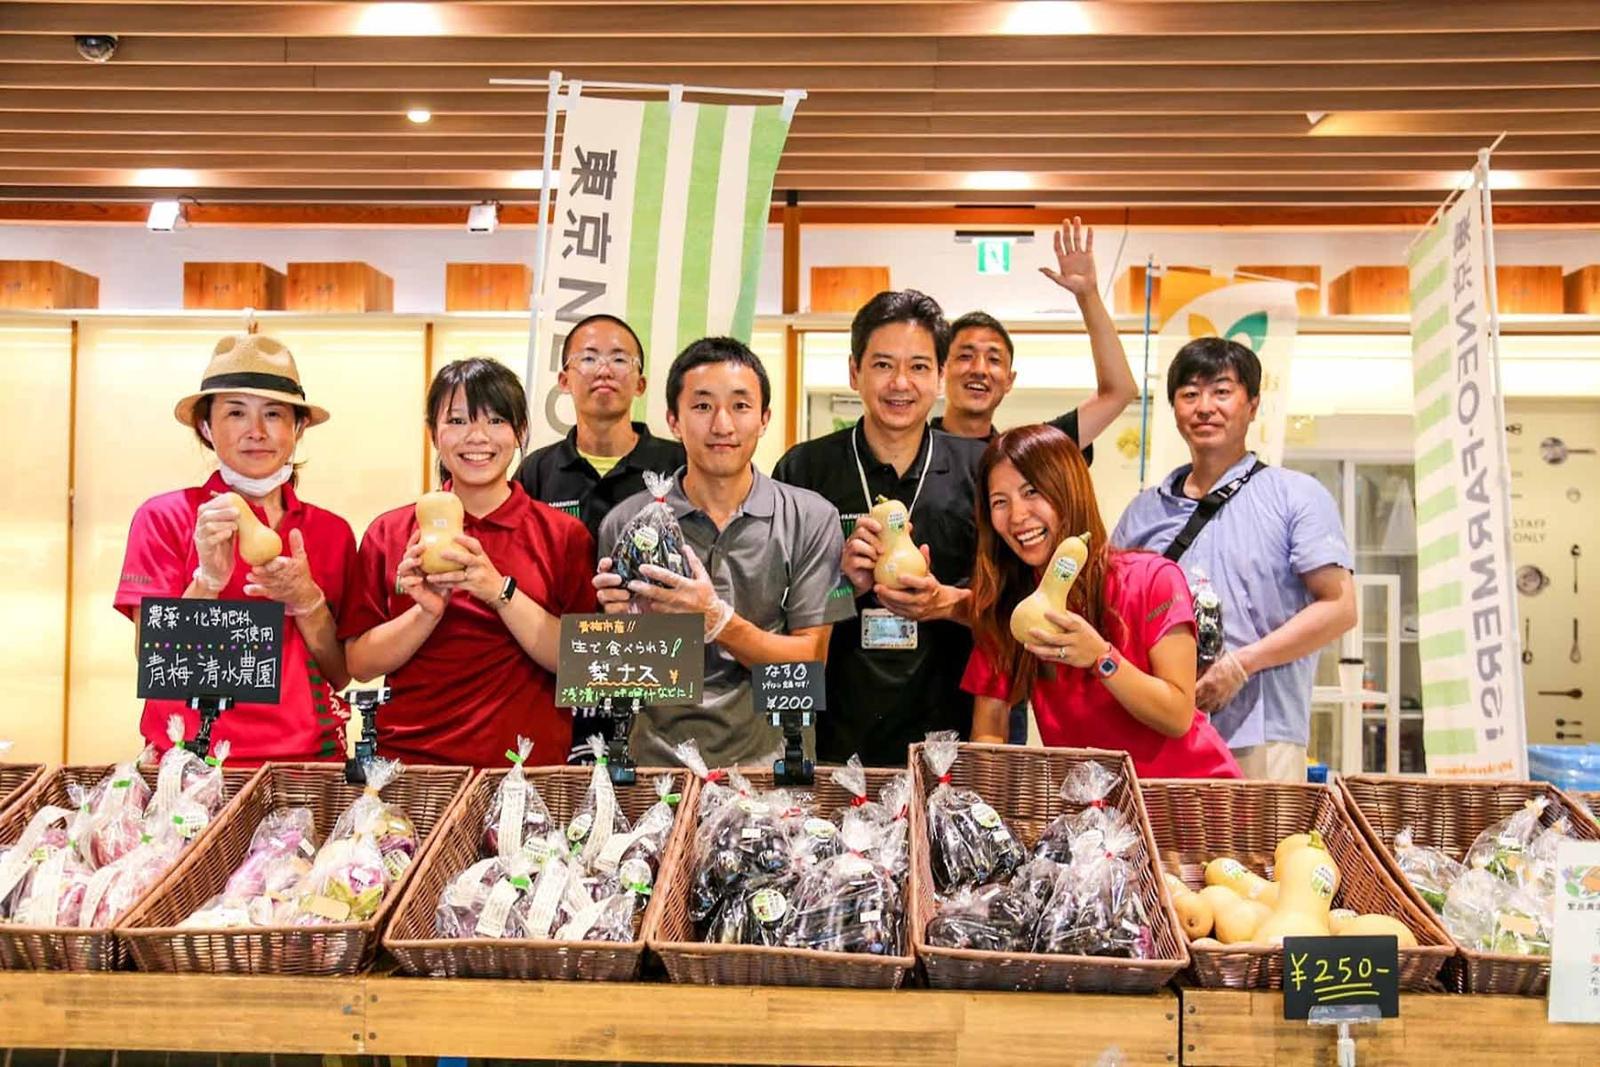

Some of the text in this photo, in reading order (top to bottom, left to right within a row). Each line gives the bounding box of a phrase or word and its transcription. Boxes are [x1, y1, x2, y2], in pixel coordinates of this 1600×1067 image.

[1513, 519, 1546, 529] STAFF
[1513, 533, 1546, 543] ONLY
[230, 626, 274, 643] 不使用
[766, 695, 814, 711] ¥200
